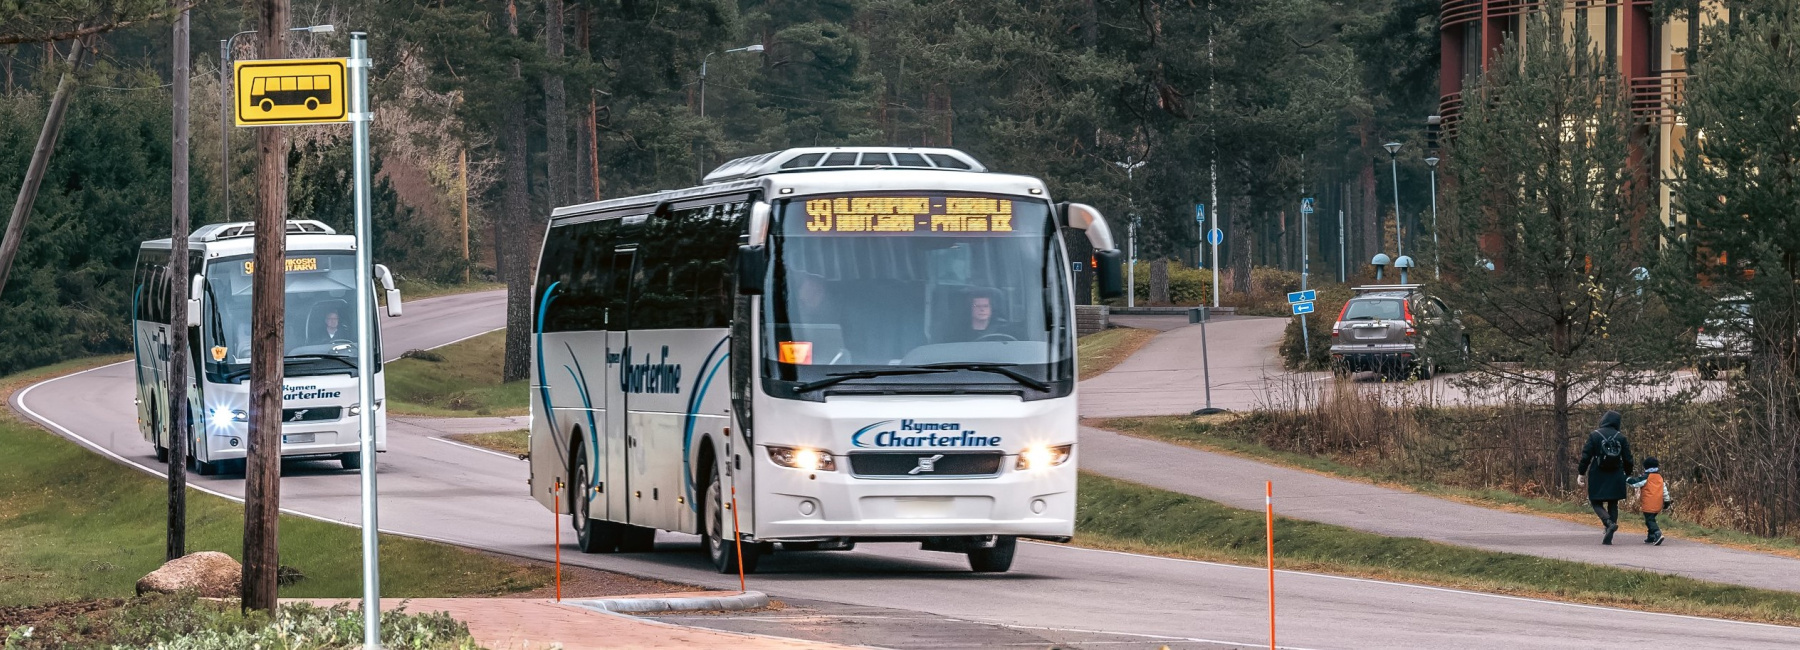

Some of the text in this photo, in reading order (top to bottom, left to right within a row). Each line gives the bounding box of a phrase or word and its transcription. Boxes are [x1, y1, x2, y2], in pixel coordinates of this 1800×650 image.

[806, 199, 833, 232] 99
[282, 384, 317, 393] Kymen
[283, 388, 341, 400] arterline
[900, 418, 960, 433] Kymen
[875, 430, 1002, 447] Charterline
